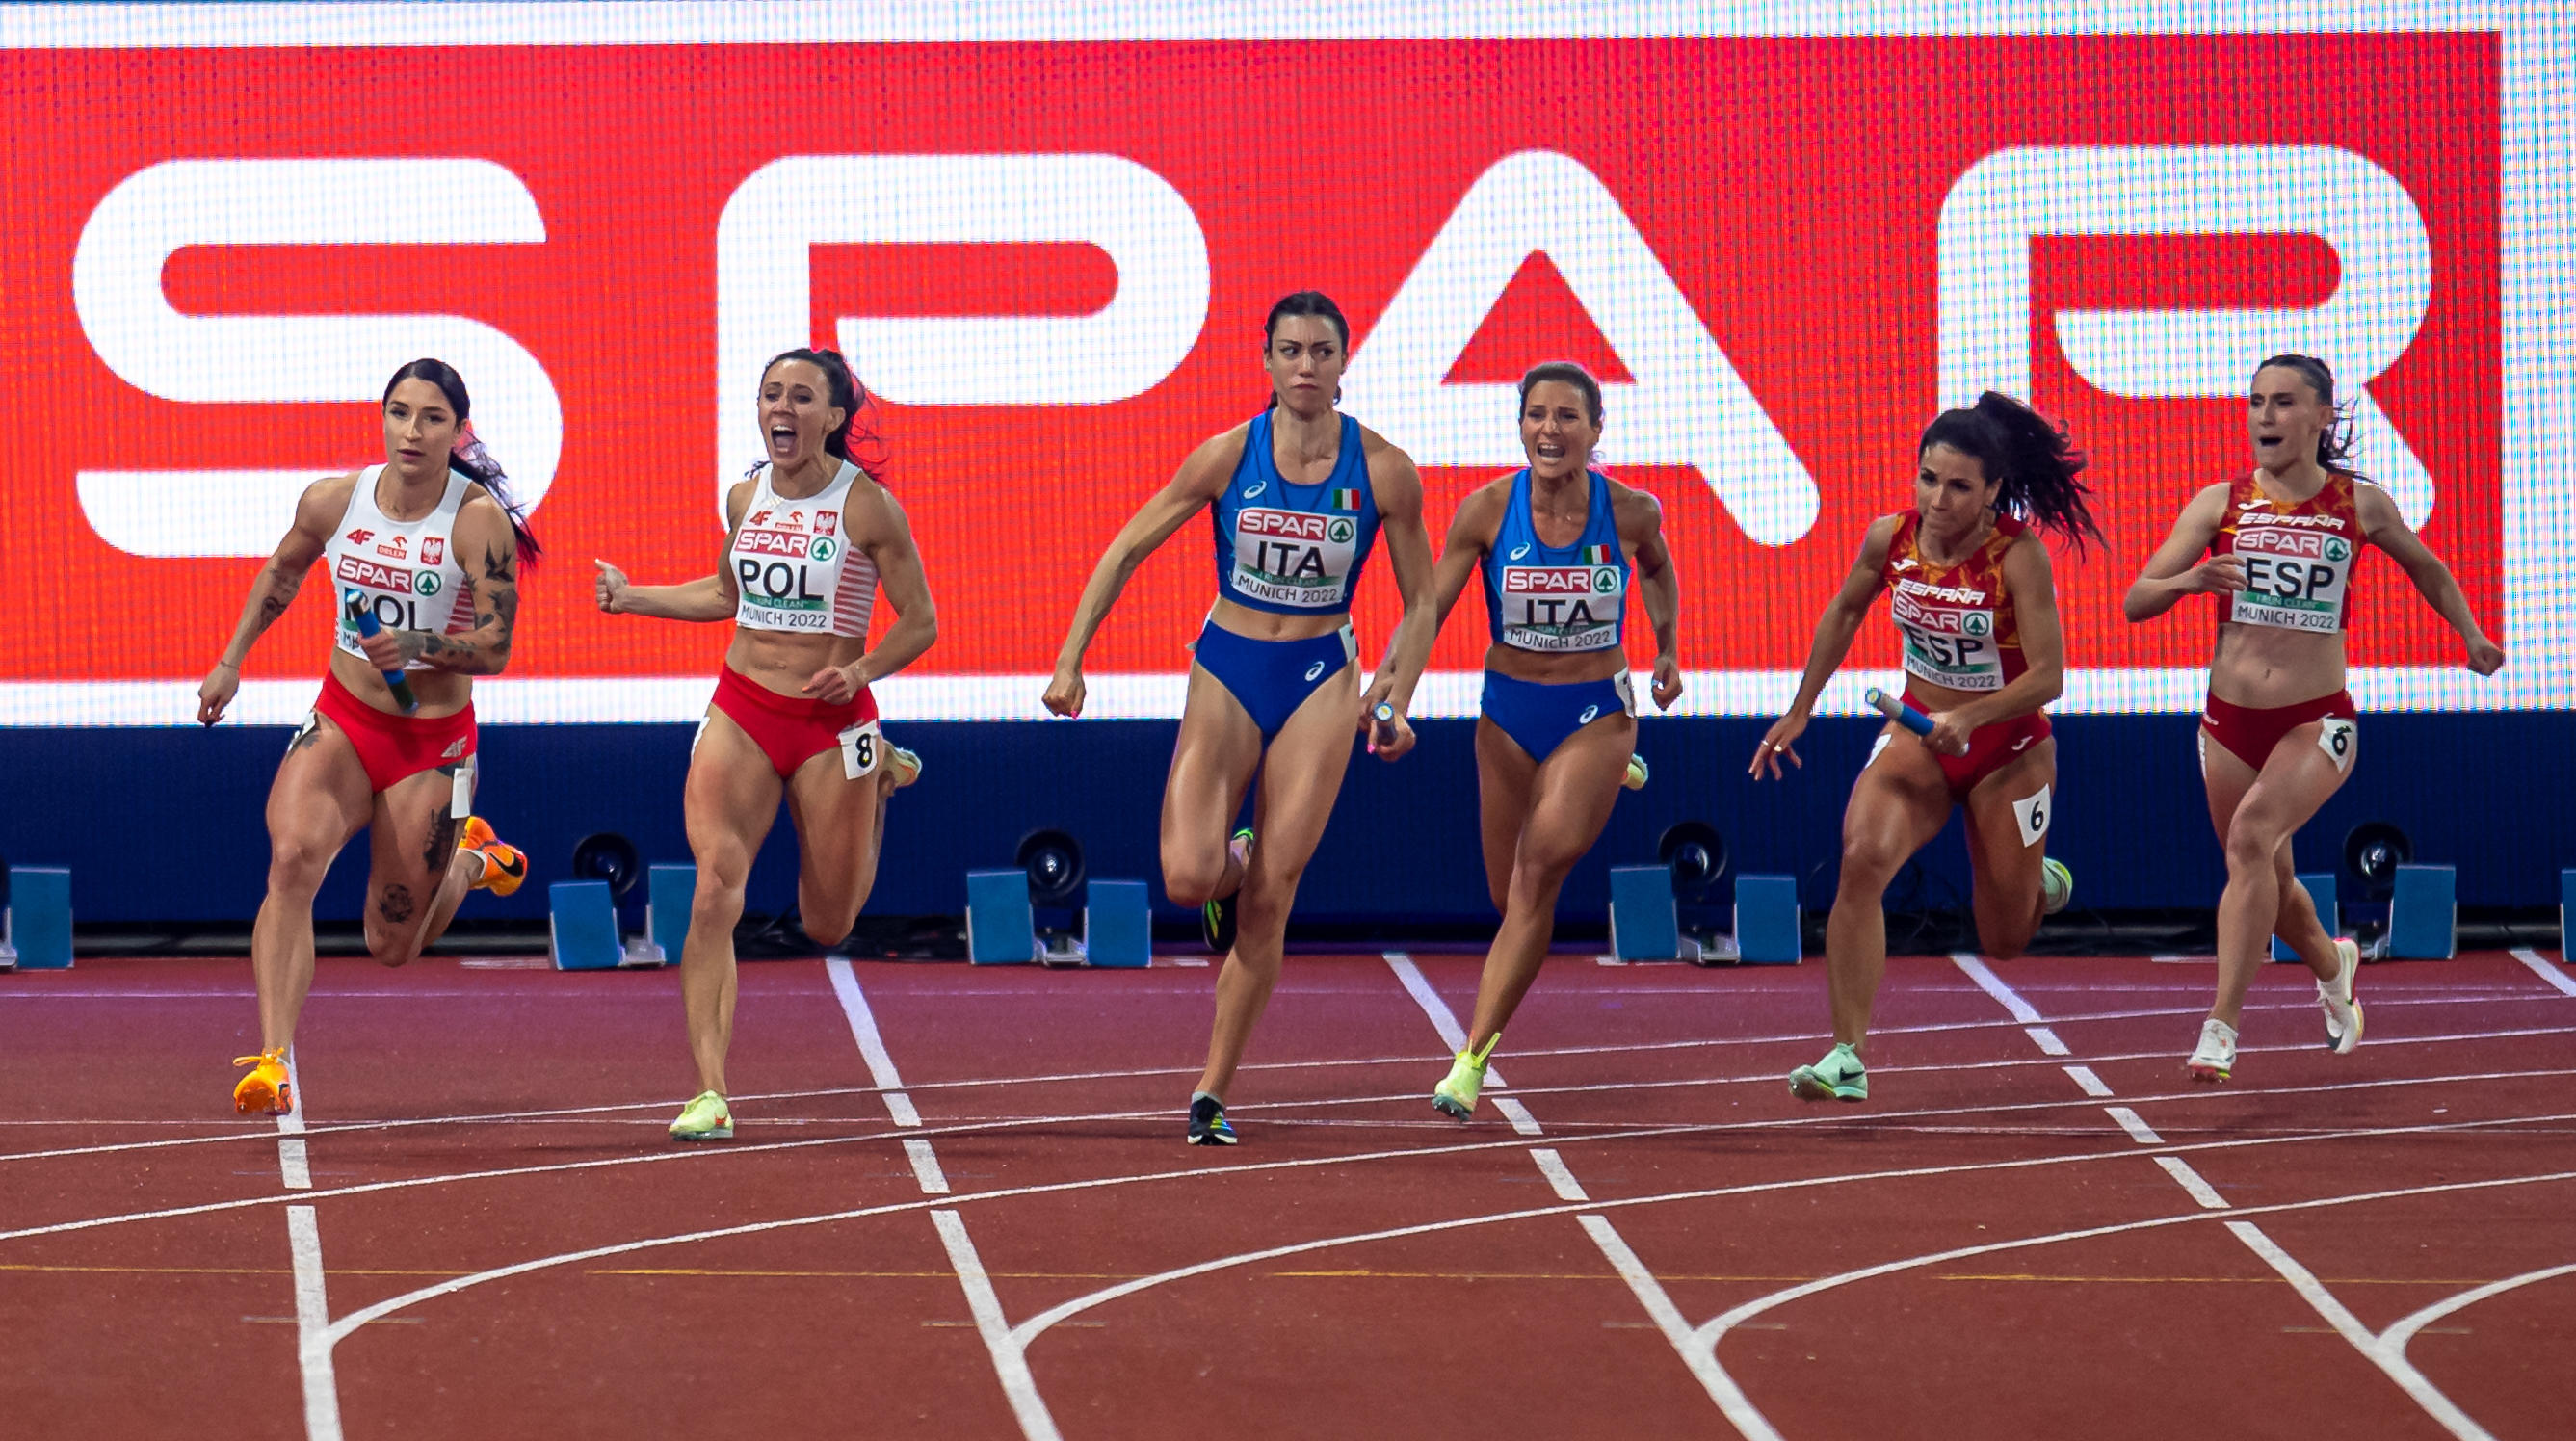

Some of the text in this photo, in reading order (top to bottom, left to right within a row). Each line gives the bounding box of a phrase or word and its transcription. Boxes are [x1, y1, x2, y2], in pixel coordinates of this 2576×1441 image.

[71, 144, 2436, 559] SPAR
[749, 511, 773, 527] 4F
[1241, 511, 1325, 538] SPAR
[2238, 511, 2345, 531] ESPAÑA
[346, 528, 375, 545] 4F
[736, 532, 808, 555] SPAR
[2237, 531, 2320, 556] SPAR
[1257, 540, 1326, 578] ITA
[339, 559, 410, 590] SPAR
[739, 558, 825, 602] POL
[1238, 575, 1338, 603] MUNICH 2022
[1508, 571, 1590, 590] SPAR
[2246, 557, 2335, 601] ESP
[1895, 578, 1986, 605] ESPAÑA
[741, 604, 827, 628] MUNICH 2022
[1526, 599, 1595, 629] ITA
[1895, 595, 1959, 631] SPAR
[2238, 605, 2336, 629] MUNICH 2022
[1511, 629, 1569, 649] MUNICH
[1574, 630, 1611, 647] 2022
[1902, 622, 1984, 666] ESP
[1906, 655, 1955, 686] MUNICH
[1958, 675, 1996, 687] 2022
[856, 732, 873, 769] 8
[2332, 725, 2353, 756] 6
[2030, 800, 2044, 832] 6
